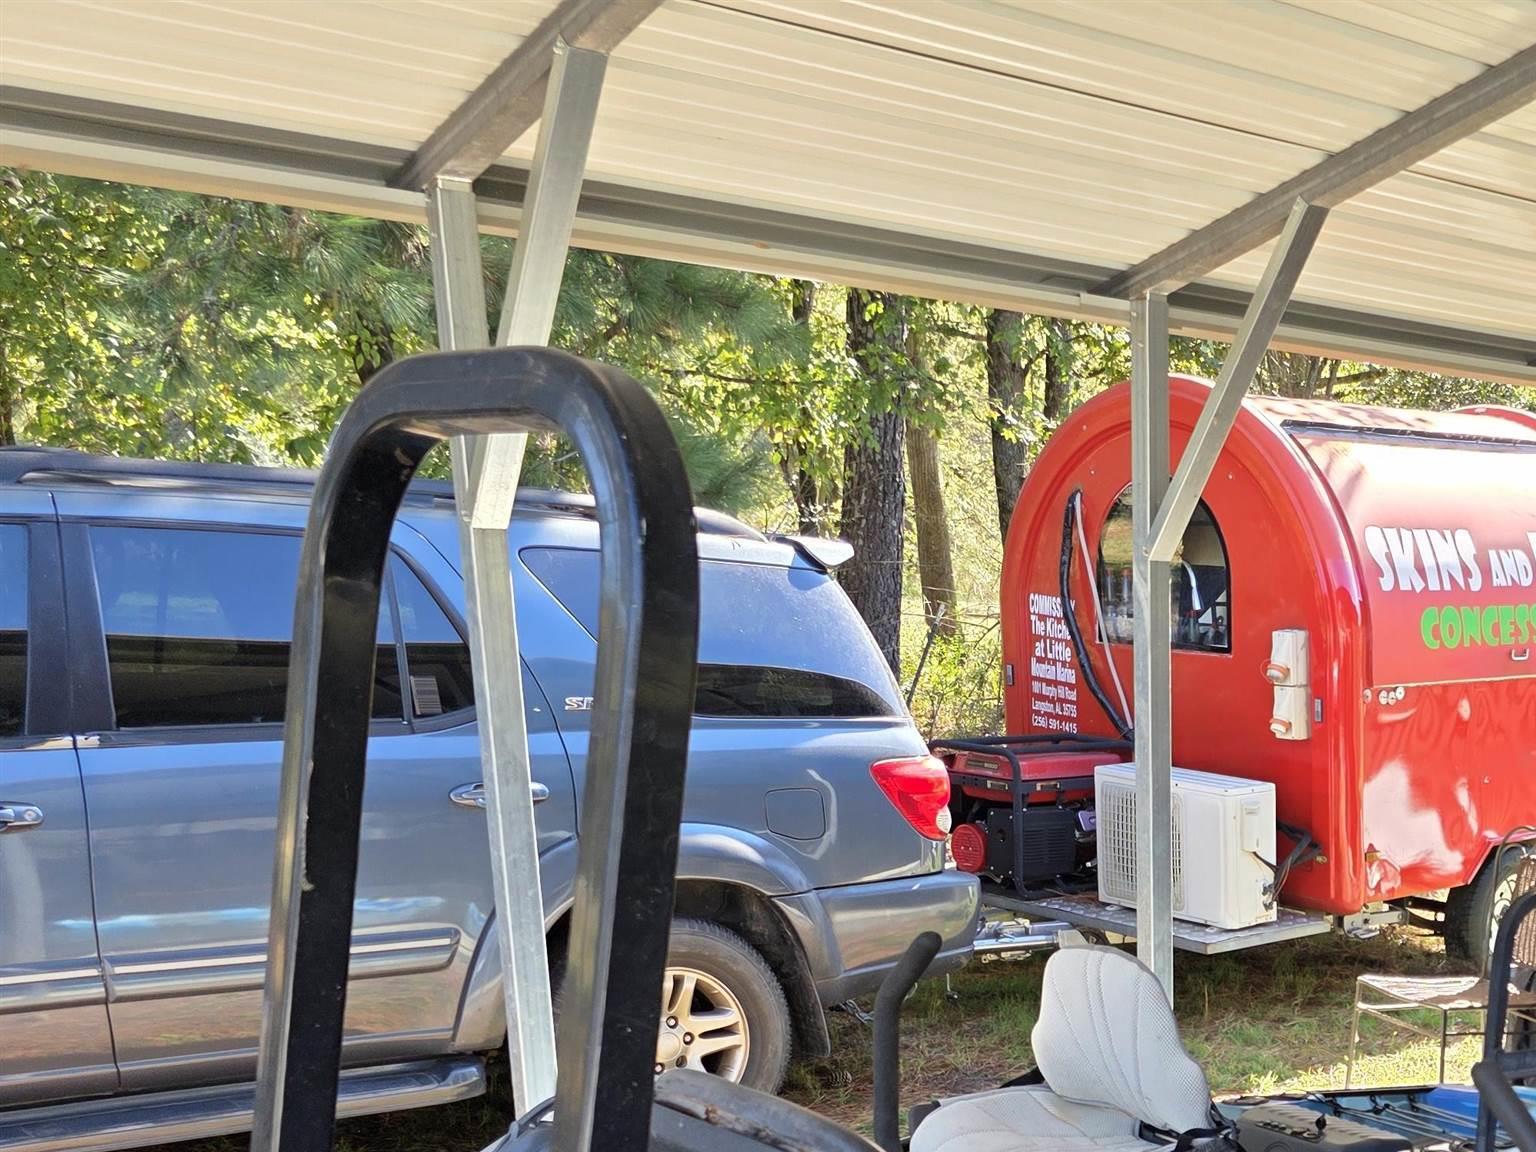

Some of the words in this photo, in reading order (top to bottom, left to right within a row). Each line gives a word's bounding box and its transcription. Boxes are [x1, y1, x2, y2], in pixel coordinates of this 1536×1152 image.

[1364, 525, 1482, 593] SKINS
[1488, 549, 1533, 587] AND
[1030, 614, 1045, 636] The
[1035, 638, 1045, 658] at
[1046, 639, 1071, 662] Little
[1031, 656, 1056, 680] Mountain
[1056, 661, 1076, 684] Marina
[1031, 713, 1048, 728] (256)
[1048, 719, 1078, 734] 591-1415
